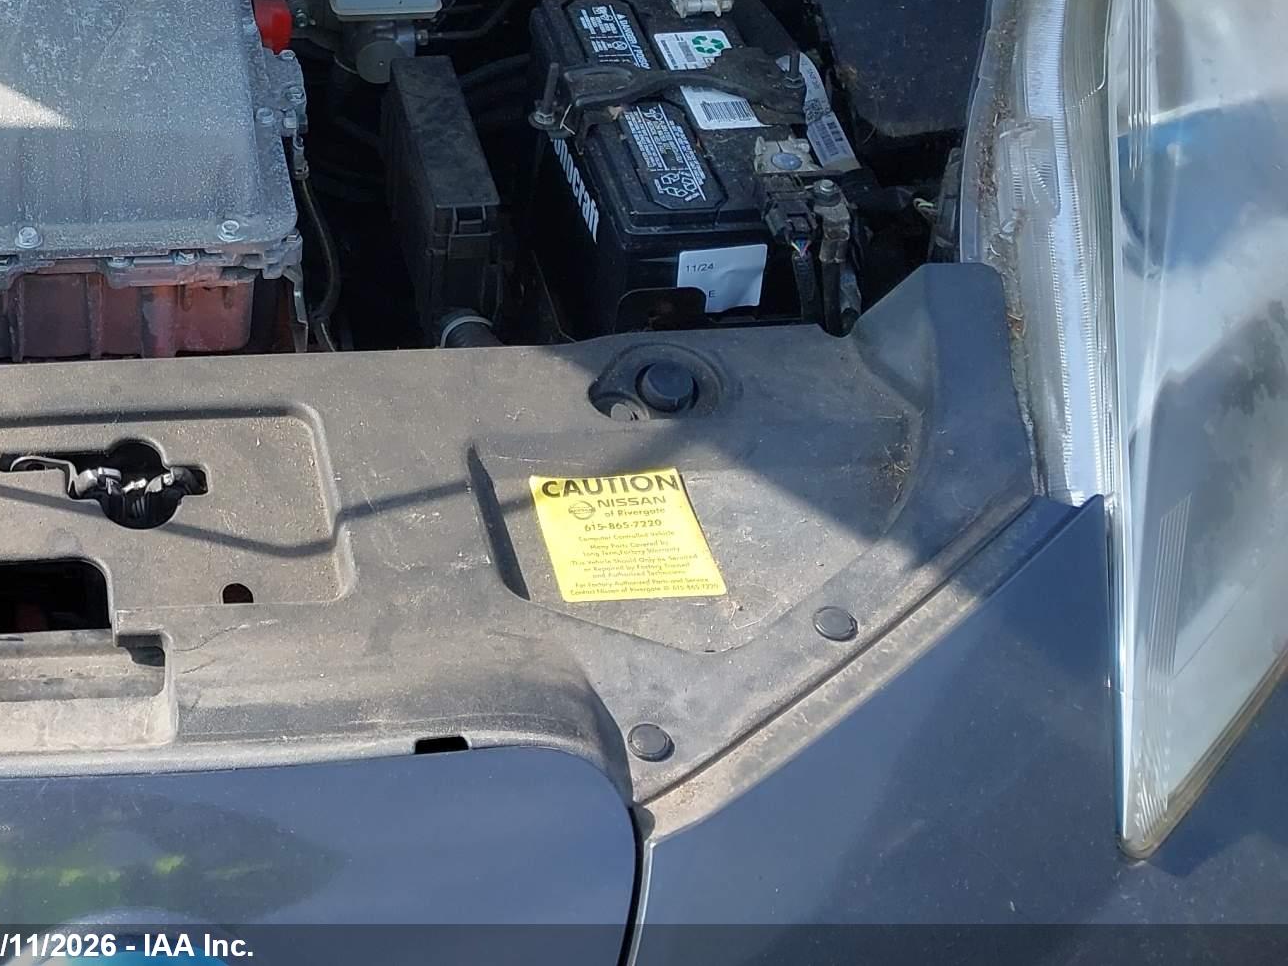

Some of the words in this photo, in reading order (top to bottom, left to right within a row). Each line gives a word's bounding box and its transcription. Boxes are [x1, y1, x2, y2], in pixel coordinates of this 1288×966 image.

[686, 262, 714, 273] 11/24
[542, 474, 680, 498] CAUTION
[597, 496, 666, 508] NISSAN
[618, 507, 665, 517] Rivergate
